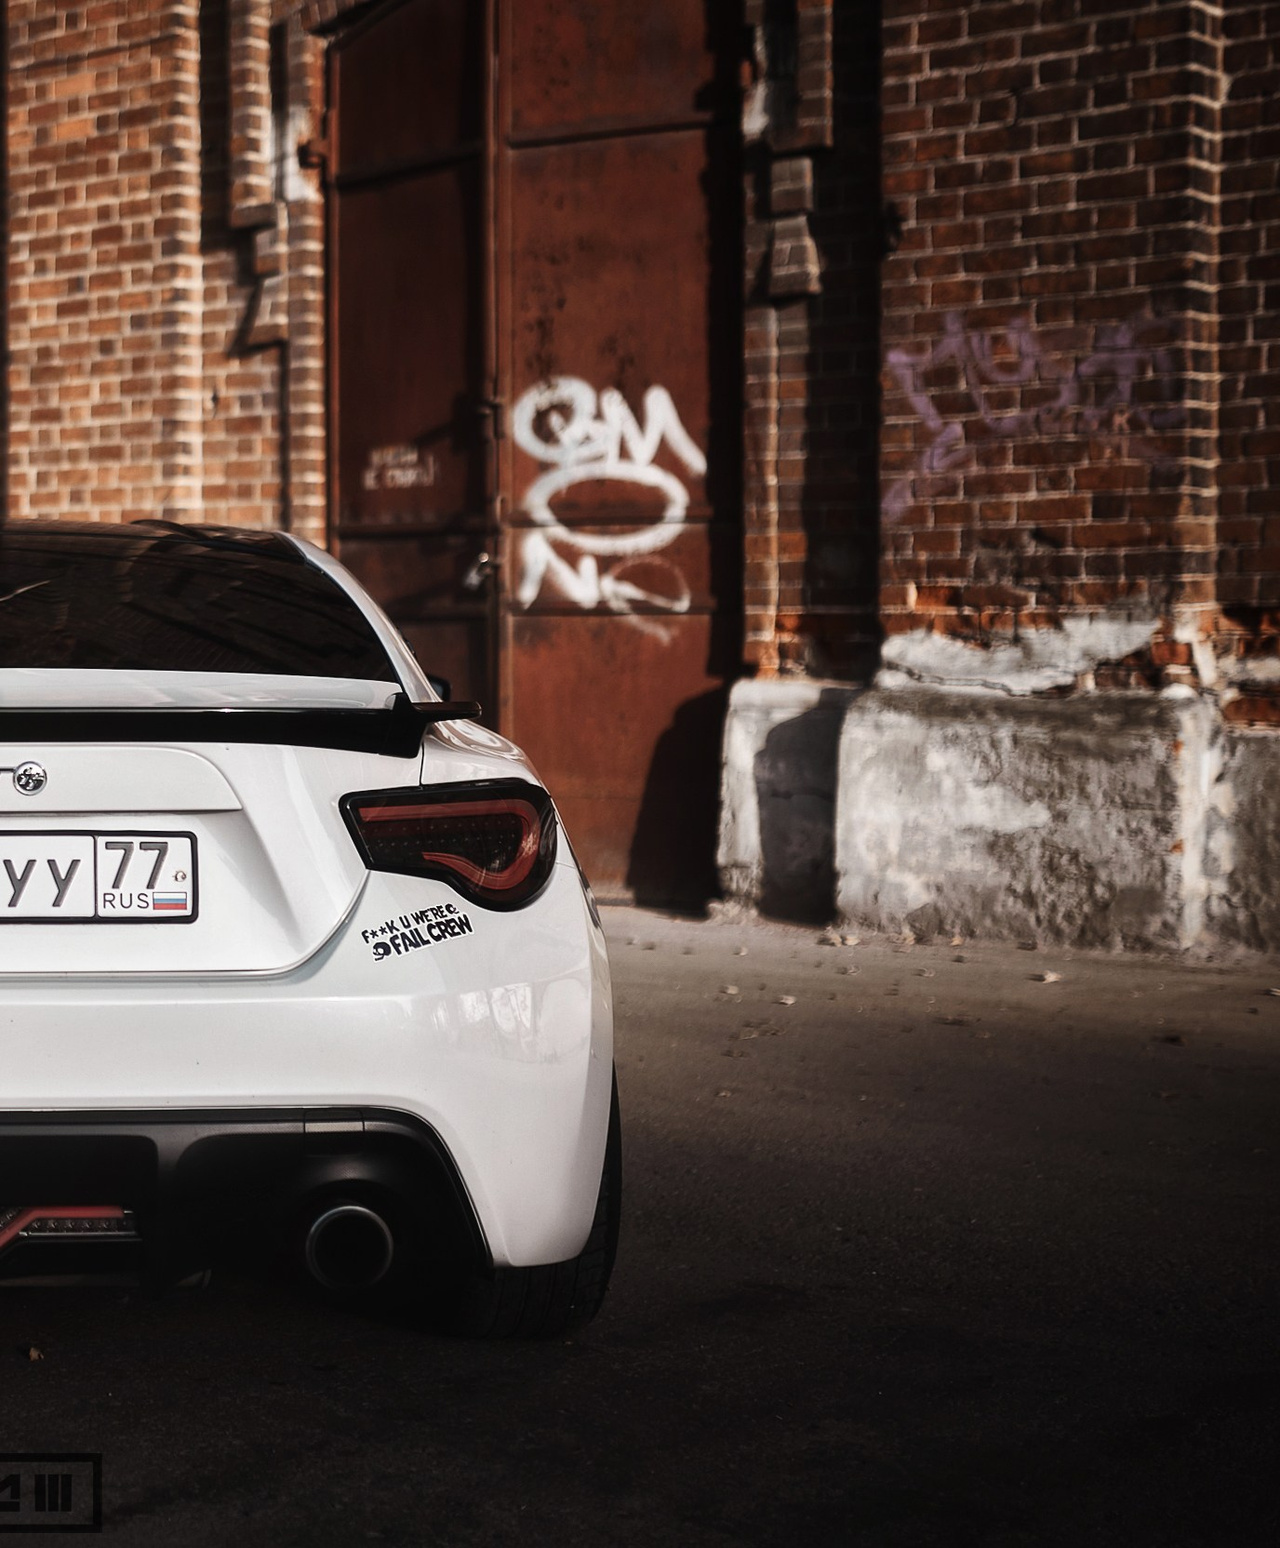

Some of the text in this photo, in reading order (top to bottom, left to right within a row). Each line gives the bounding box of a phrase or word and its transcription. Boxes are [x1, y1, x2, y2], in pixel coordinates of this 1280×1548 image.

[105, 842, 168, 889] 77
[103, 893, 150, 909] RUS
[389, 914, 473, 955] FAIL CREW
[399, 915, 412, 929] U
